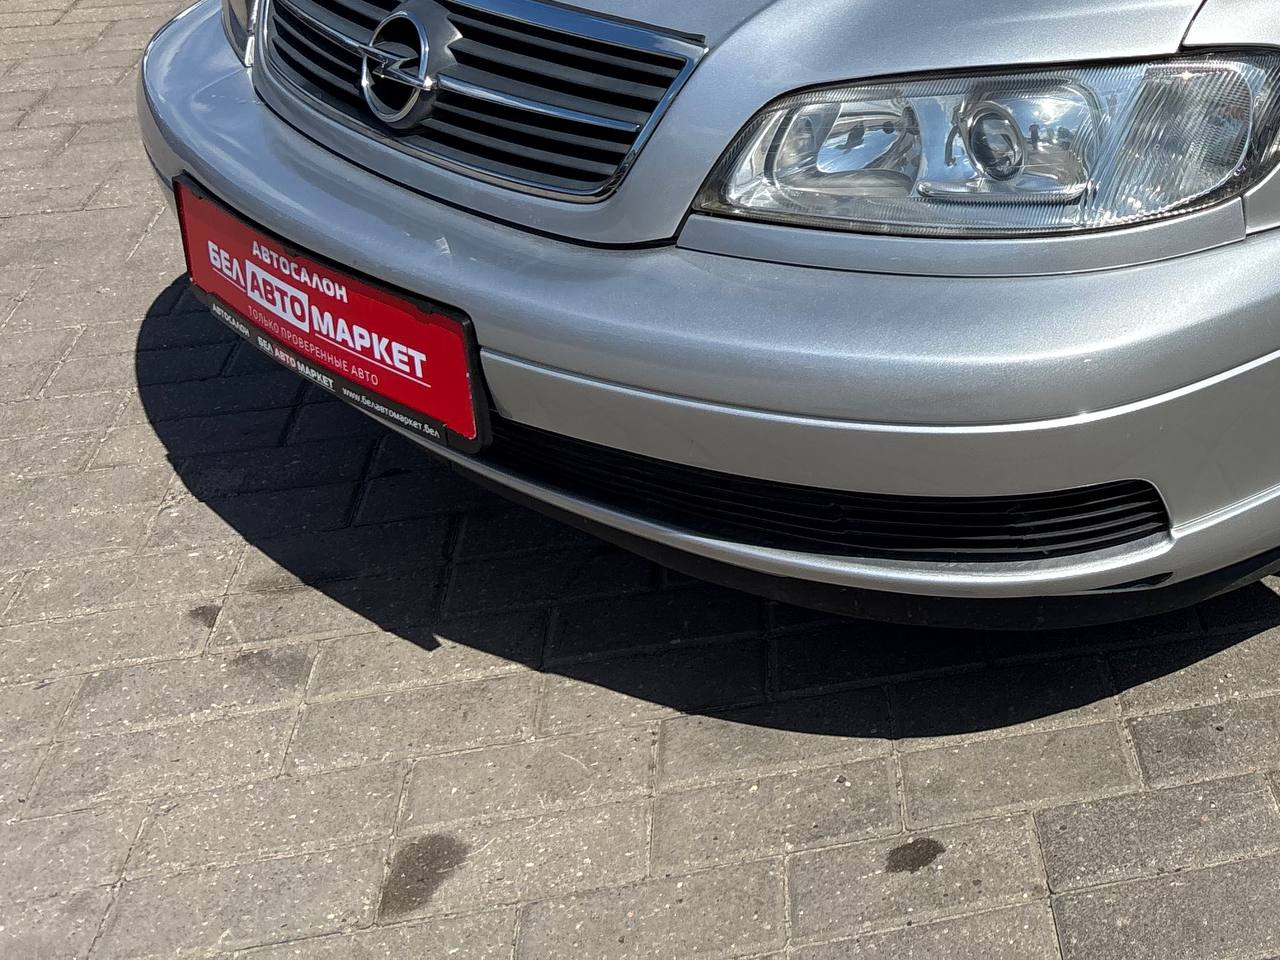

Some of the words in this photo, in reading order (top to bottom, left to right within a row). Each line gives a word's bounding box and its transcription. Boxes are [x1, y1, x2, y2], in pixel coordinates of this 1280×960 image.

[252, 239, 349, 304] АВТОСАЛОН
[212, 303, 251, 338] АВТОСАЛОН
[248, 305, 280, 334] ТОЛЬКО
[280, 325, 350, 373] ПРОВЕРЕННЫЕ
[351, 364, 380, 387] АВТО
